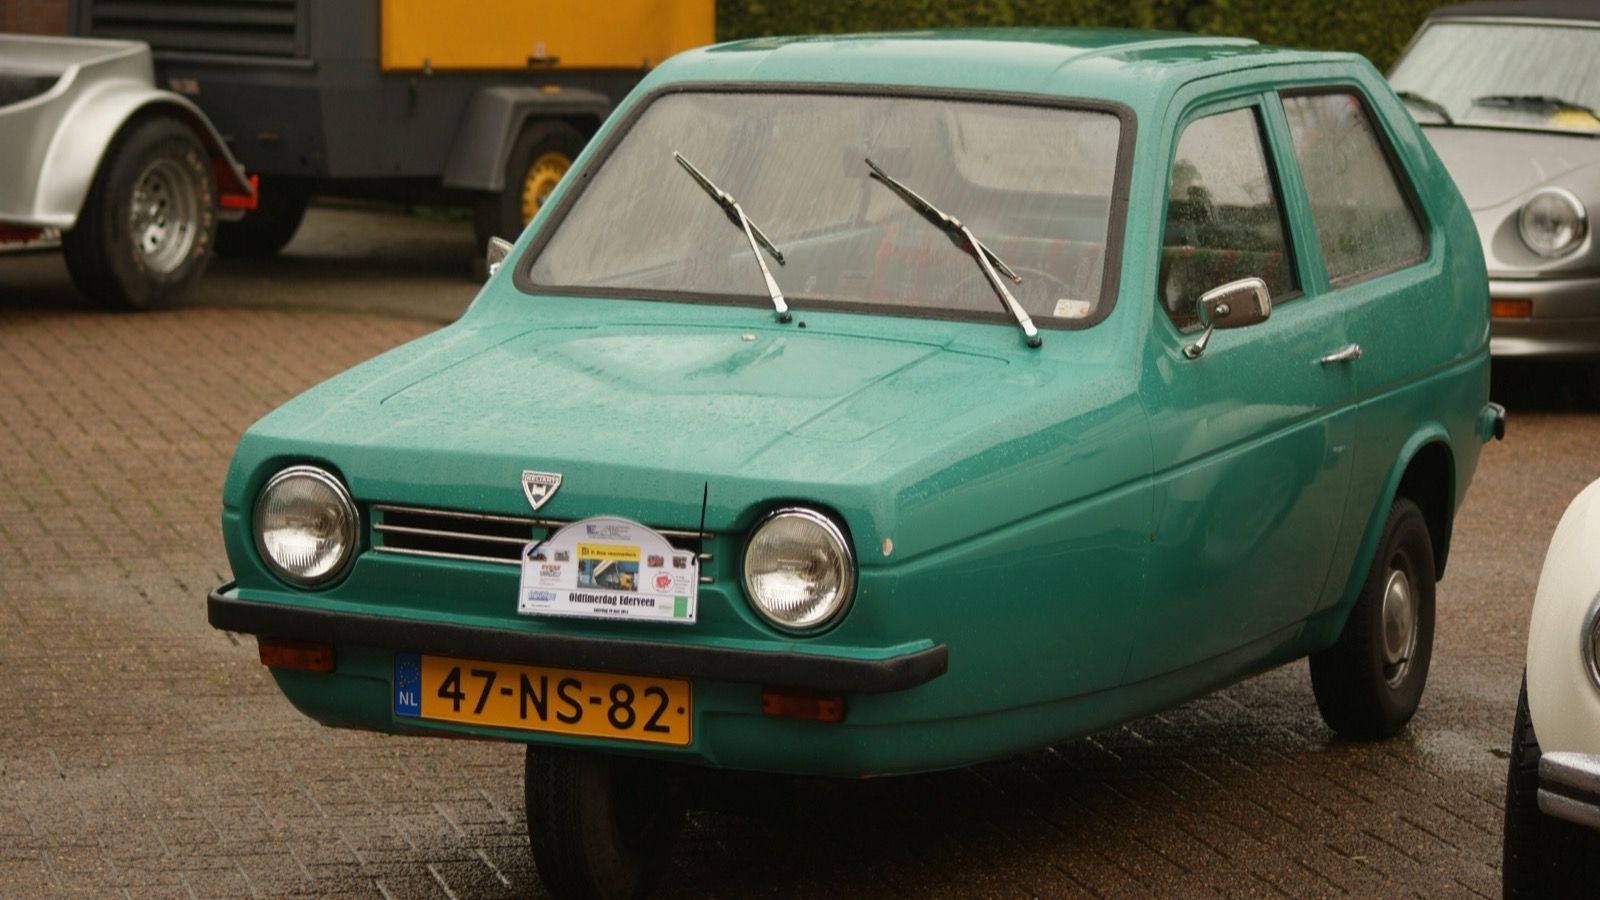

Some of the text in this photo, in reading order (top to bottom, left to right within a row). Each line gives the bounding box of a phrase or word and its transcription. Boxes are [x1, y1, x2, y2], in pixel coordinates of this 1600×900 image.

[569, 592, 618, 606] Oldtimerdag
[619, 595, 656, 608] Ederveen
[399, 691, 418, 707] NL
[437, 666, 671, 733] 47-NS-82
